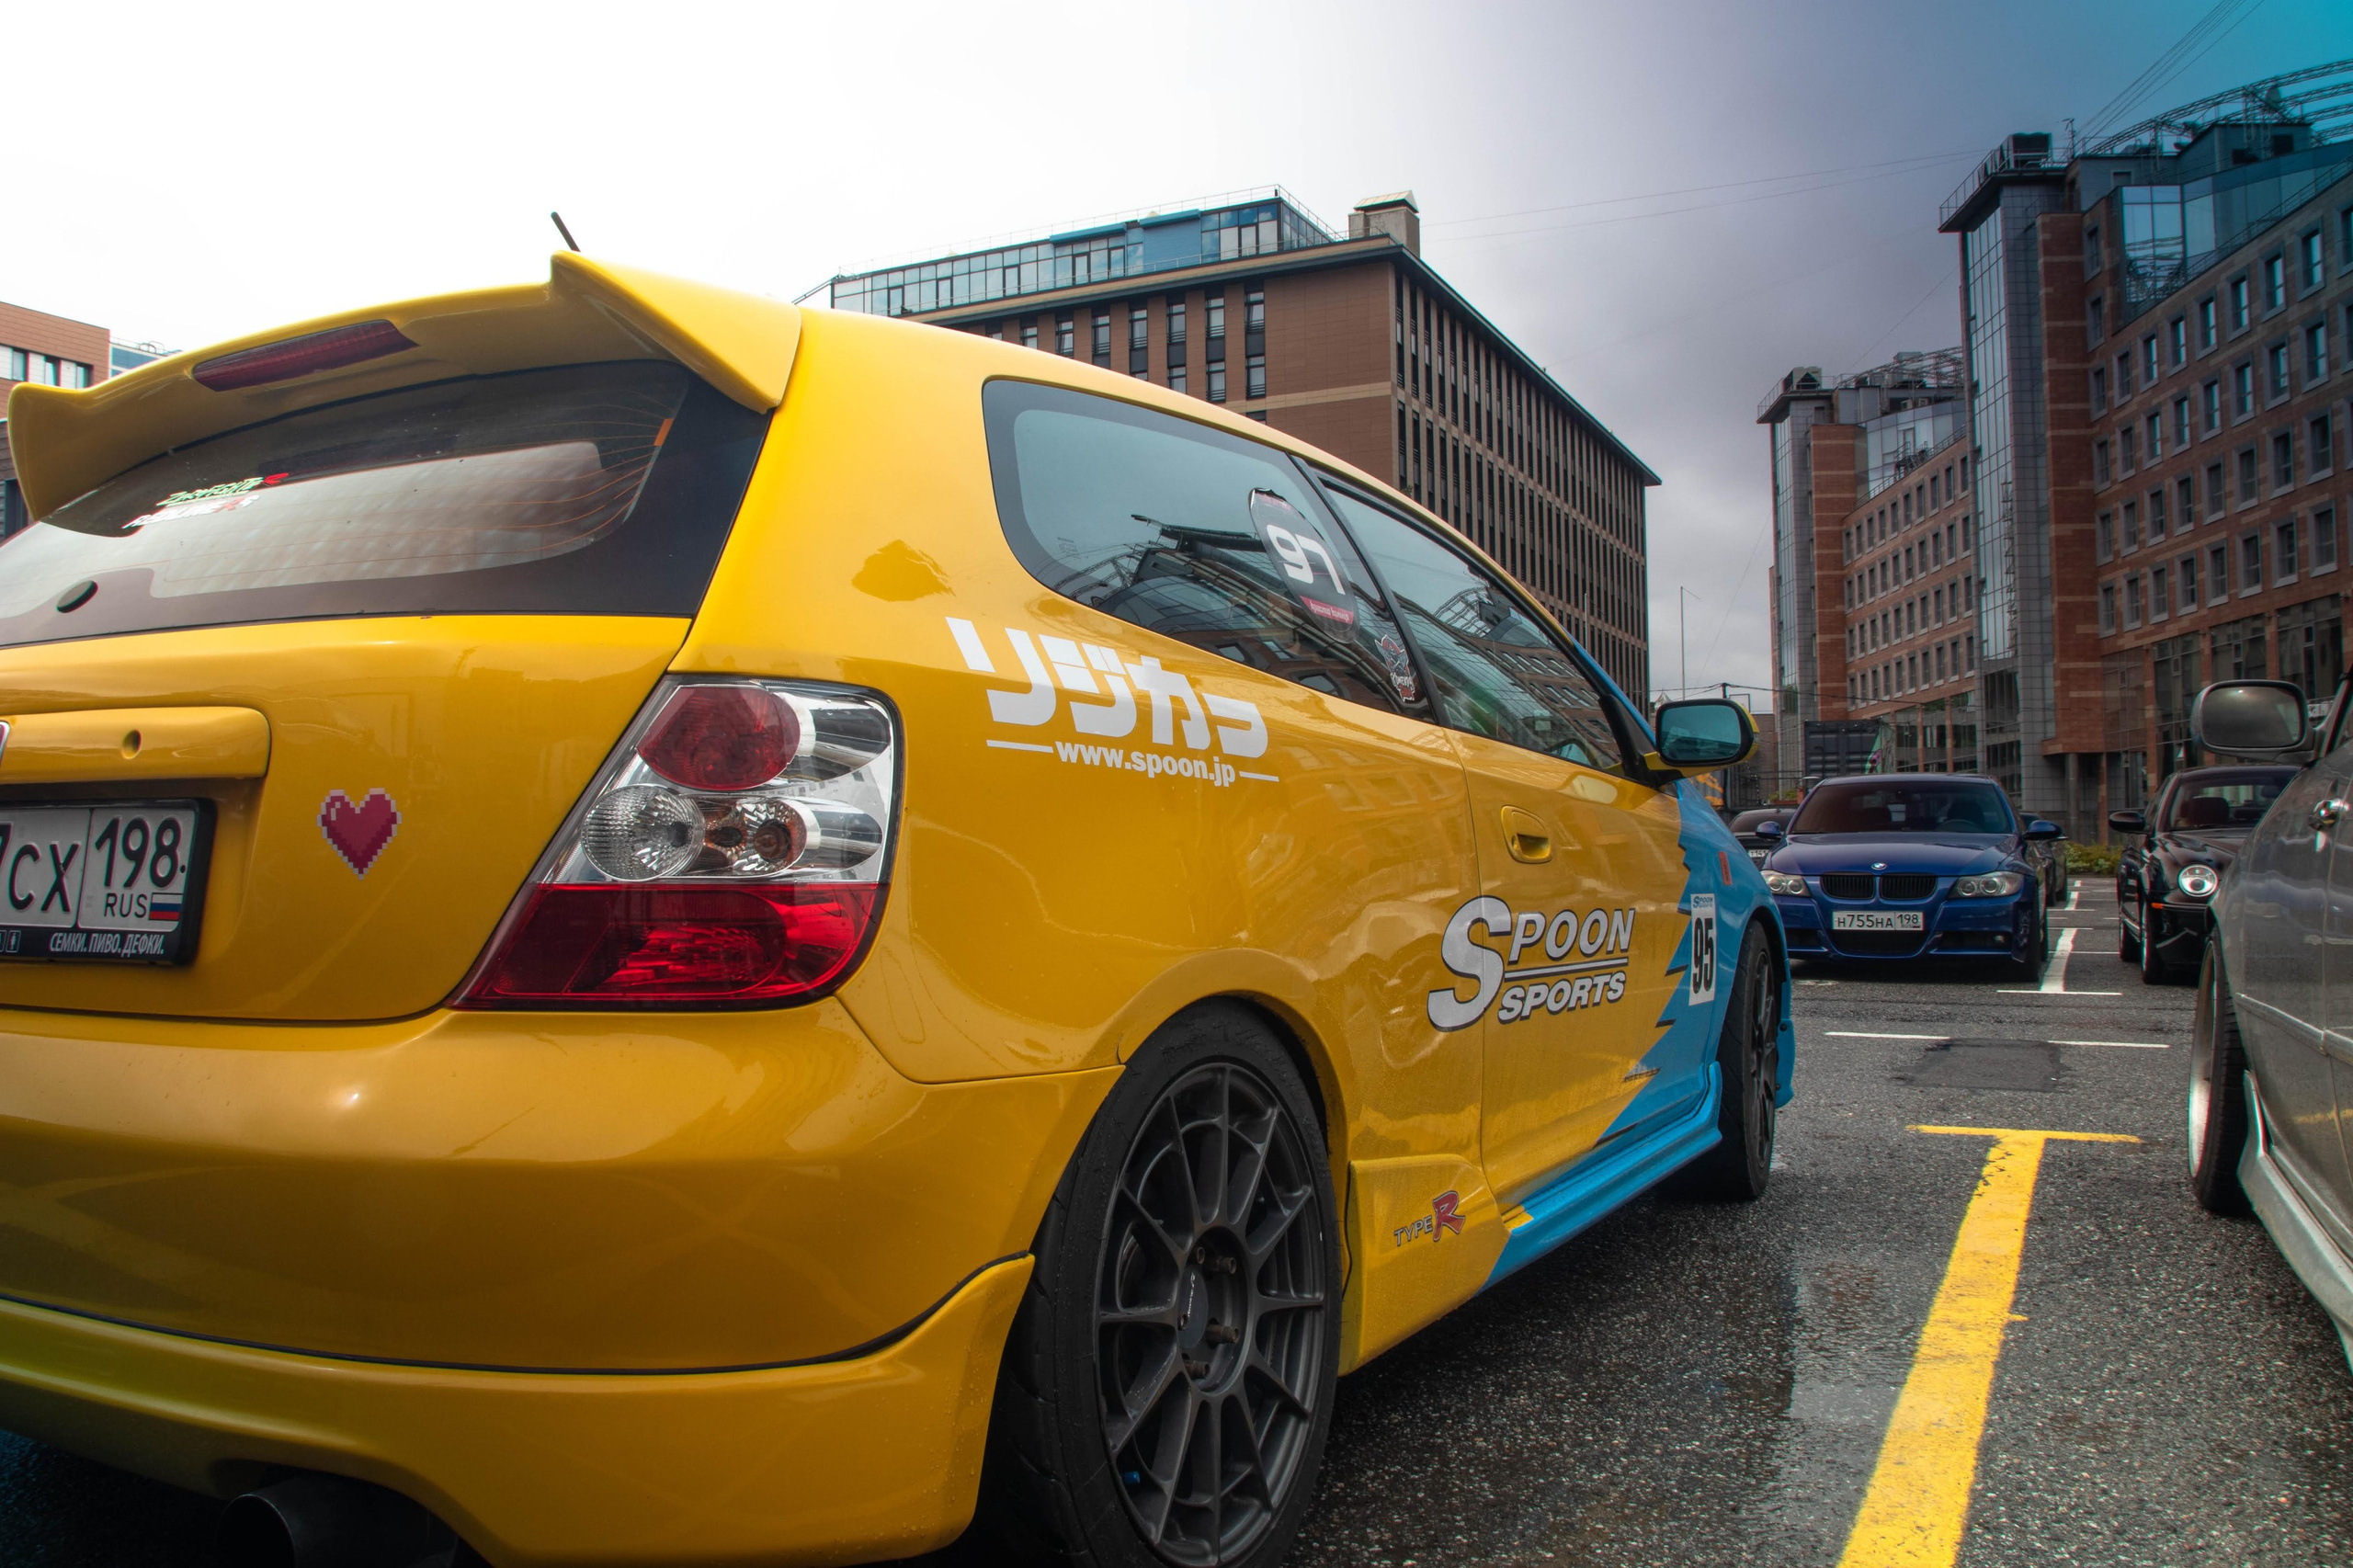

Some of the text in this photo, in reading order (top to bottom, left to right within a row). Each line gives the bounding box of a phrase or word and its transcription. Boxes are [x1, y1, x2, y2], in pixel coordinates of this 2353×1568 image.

[1267, 524, 1346, 596] 97
[1055, 741, 1235, 787] www.spoon.jp
[96, 817, 182, 888] 198
[104, 892, 148, 917] RUS
[1837, 913, 1919, 928] Н755НА 198
[1427, 894, 1635, 1032] SPOON
[1693, 917, 1714, 994] 95
[1497, 971, 1627, 1025] SPORTS
[1394, 1190, 1466, 1246] TYPE R
